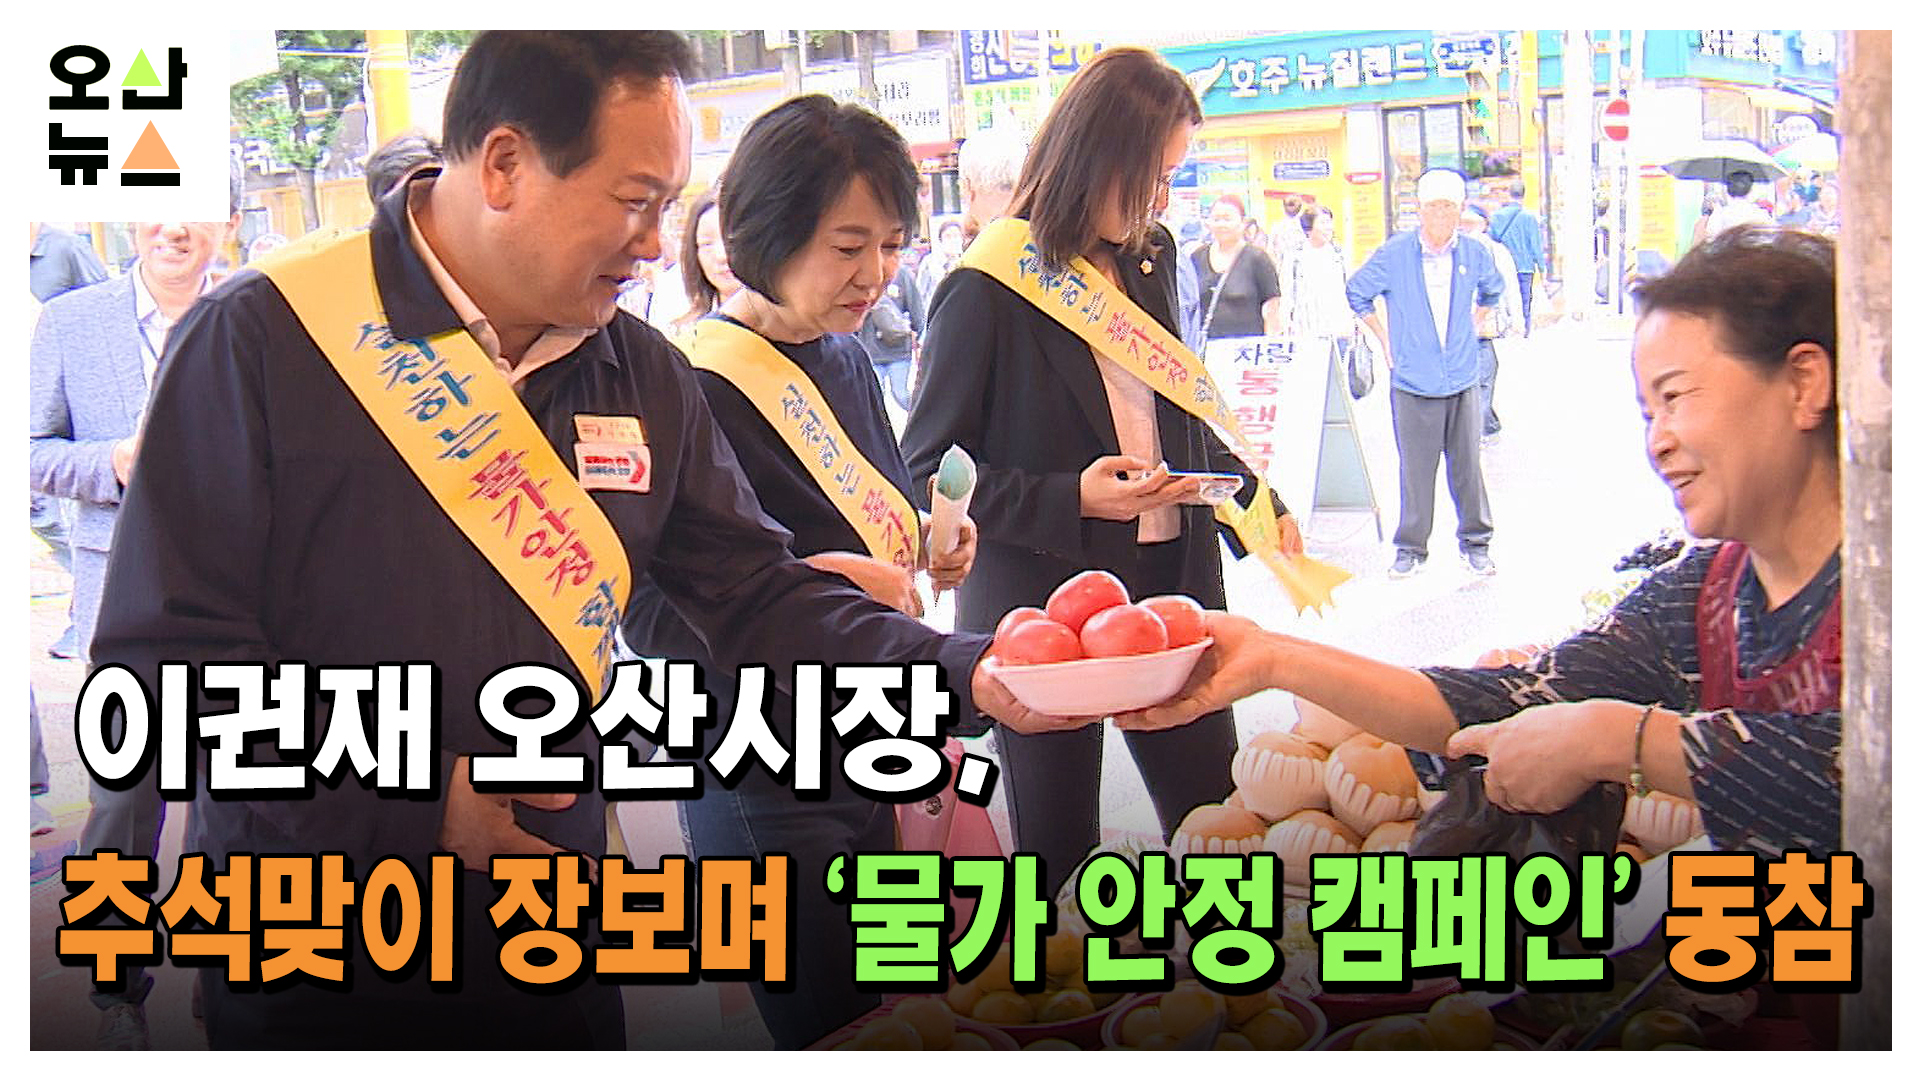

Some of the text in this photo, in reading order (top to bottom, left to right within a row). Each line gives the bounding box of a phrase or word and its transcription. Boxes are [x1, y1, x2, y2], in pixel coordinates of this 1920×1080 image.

[1228, 56, 1290, 98] 호주
[1297, 42, 1429, 90] 뉴질랜드
[1105, 310, 1189, 390] 물가안정
[464, 448, 599, 598] 물가안정
